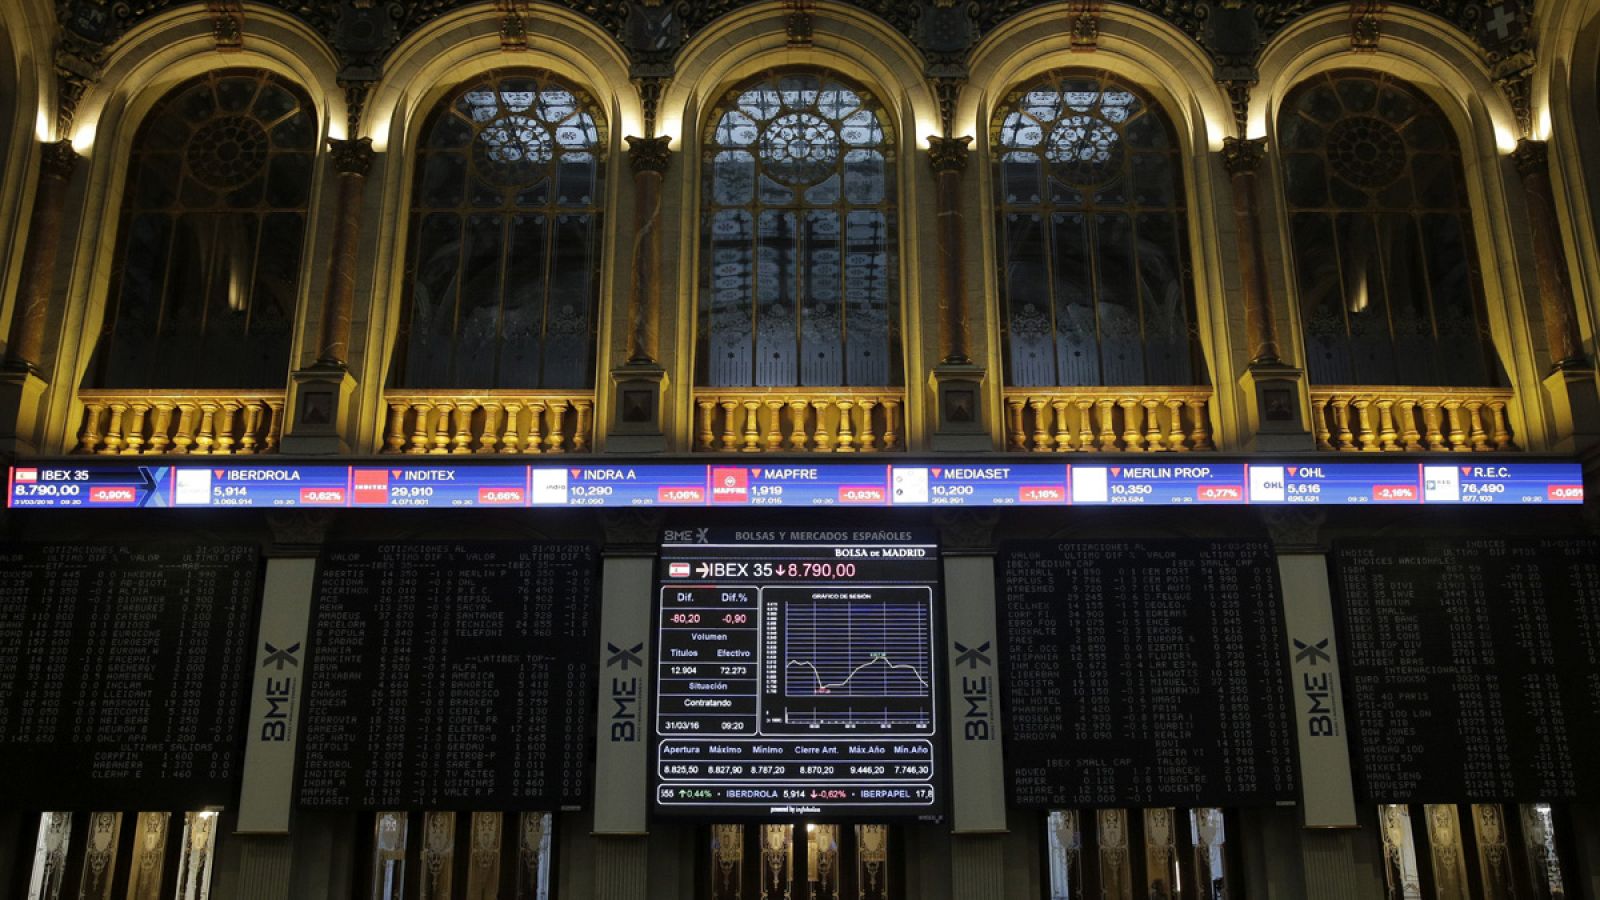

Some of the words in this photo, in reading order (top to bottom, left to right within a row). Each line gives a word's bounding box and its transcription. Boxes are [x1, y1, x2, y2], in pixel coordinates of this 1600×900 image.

[42, 471, 71, 480] IBEX
[74, 471, 89, 480] 35
[228, 470, 301, 480] IBERDROLA
[405, 470, 456, 480] INDITEX
[584, 470, 624, 480] INDRA
[626, 470, 638, 480] A
[765, 469, 818, 479] MAPFRE
[945, 469, 1012, 479] MEDIASET
[1123, 468, 1171, 478] MERLIN
[1175, 468, 1214, 478] PROP.
[1300, 467, 1326, 477] OHL
[1474, 467, 1512, 477] R.E.C.
[15, 484, 81, 496] 8.790,00
[214, 486, 248, 497] 5,914
[391, 487, 433, 498] 29,910
[571, 486, 613, 497] 10,290
[751, 486, 783, 497] 1,919
[931, 486, 974, 496] 10,200
[1111, 485, 1153, 496] 10,350
[1202, 489, 1240, 499] -0,77%
[1287, 484, 1321, 495] 5,616
[1462, 483, 1505, 494] 76,490
[735, 532, 775, 541] BOLSAS
[779, 532, 786, 541] Y
[790, 532, 848, 541] MERCADOS
[852, 530, 912, 541] ESPAÑOLES
[834, 549, 869, 558] BOLSA
[882, 549, 927, 558] MADRID
[708, 563, 750, 577] IBEX
[753, 563, 773, 577] 35
[788, 563, 857, 580] 8.790,00
[677, 592, 695, 602] Dif.
[721, 592, 748, 603] Dif.%
[670, 613, 701, 625] -80,20
[721, 613, 747, 625] -0,90
[691, 632, 728, 642] Volumen
[716, 648, 751, 657] Efectivo
[688, 681, 729, 691] Situación
[683, 698, 732, 708] Contratando
[962, 676, 989, 741] BME
[1304, 672, 1333, 737] BME
[261, 677, 291, 742] BME
[611, 677, 637, 742] BME
[664, 721, 701, 731] 31/03/16
[721, 721, 745, 731] 09:20
[663, 745, 701, 756] Apertura
[708, 744, 743, 755] Máximo
[795, 745, 821, 755] Cierre
[822, 745, 840, 755] Ant.
[750, 765, 786, 776] 8.787,20
[799, 765, 835, 776] 8.870,20
[687, 789, 713, 800] 0,44%
[726, 789, 778, 799] IBERDROLA
[782, 789, 805, 800] 5,914
[818, 789, 847, 801] -0,62%
[860, 789, 912, 799] IBERPAPEL
